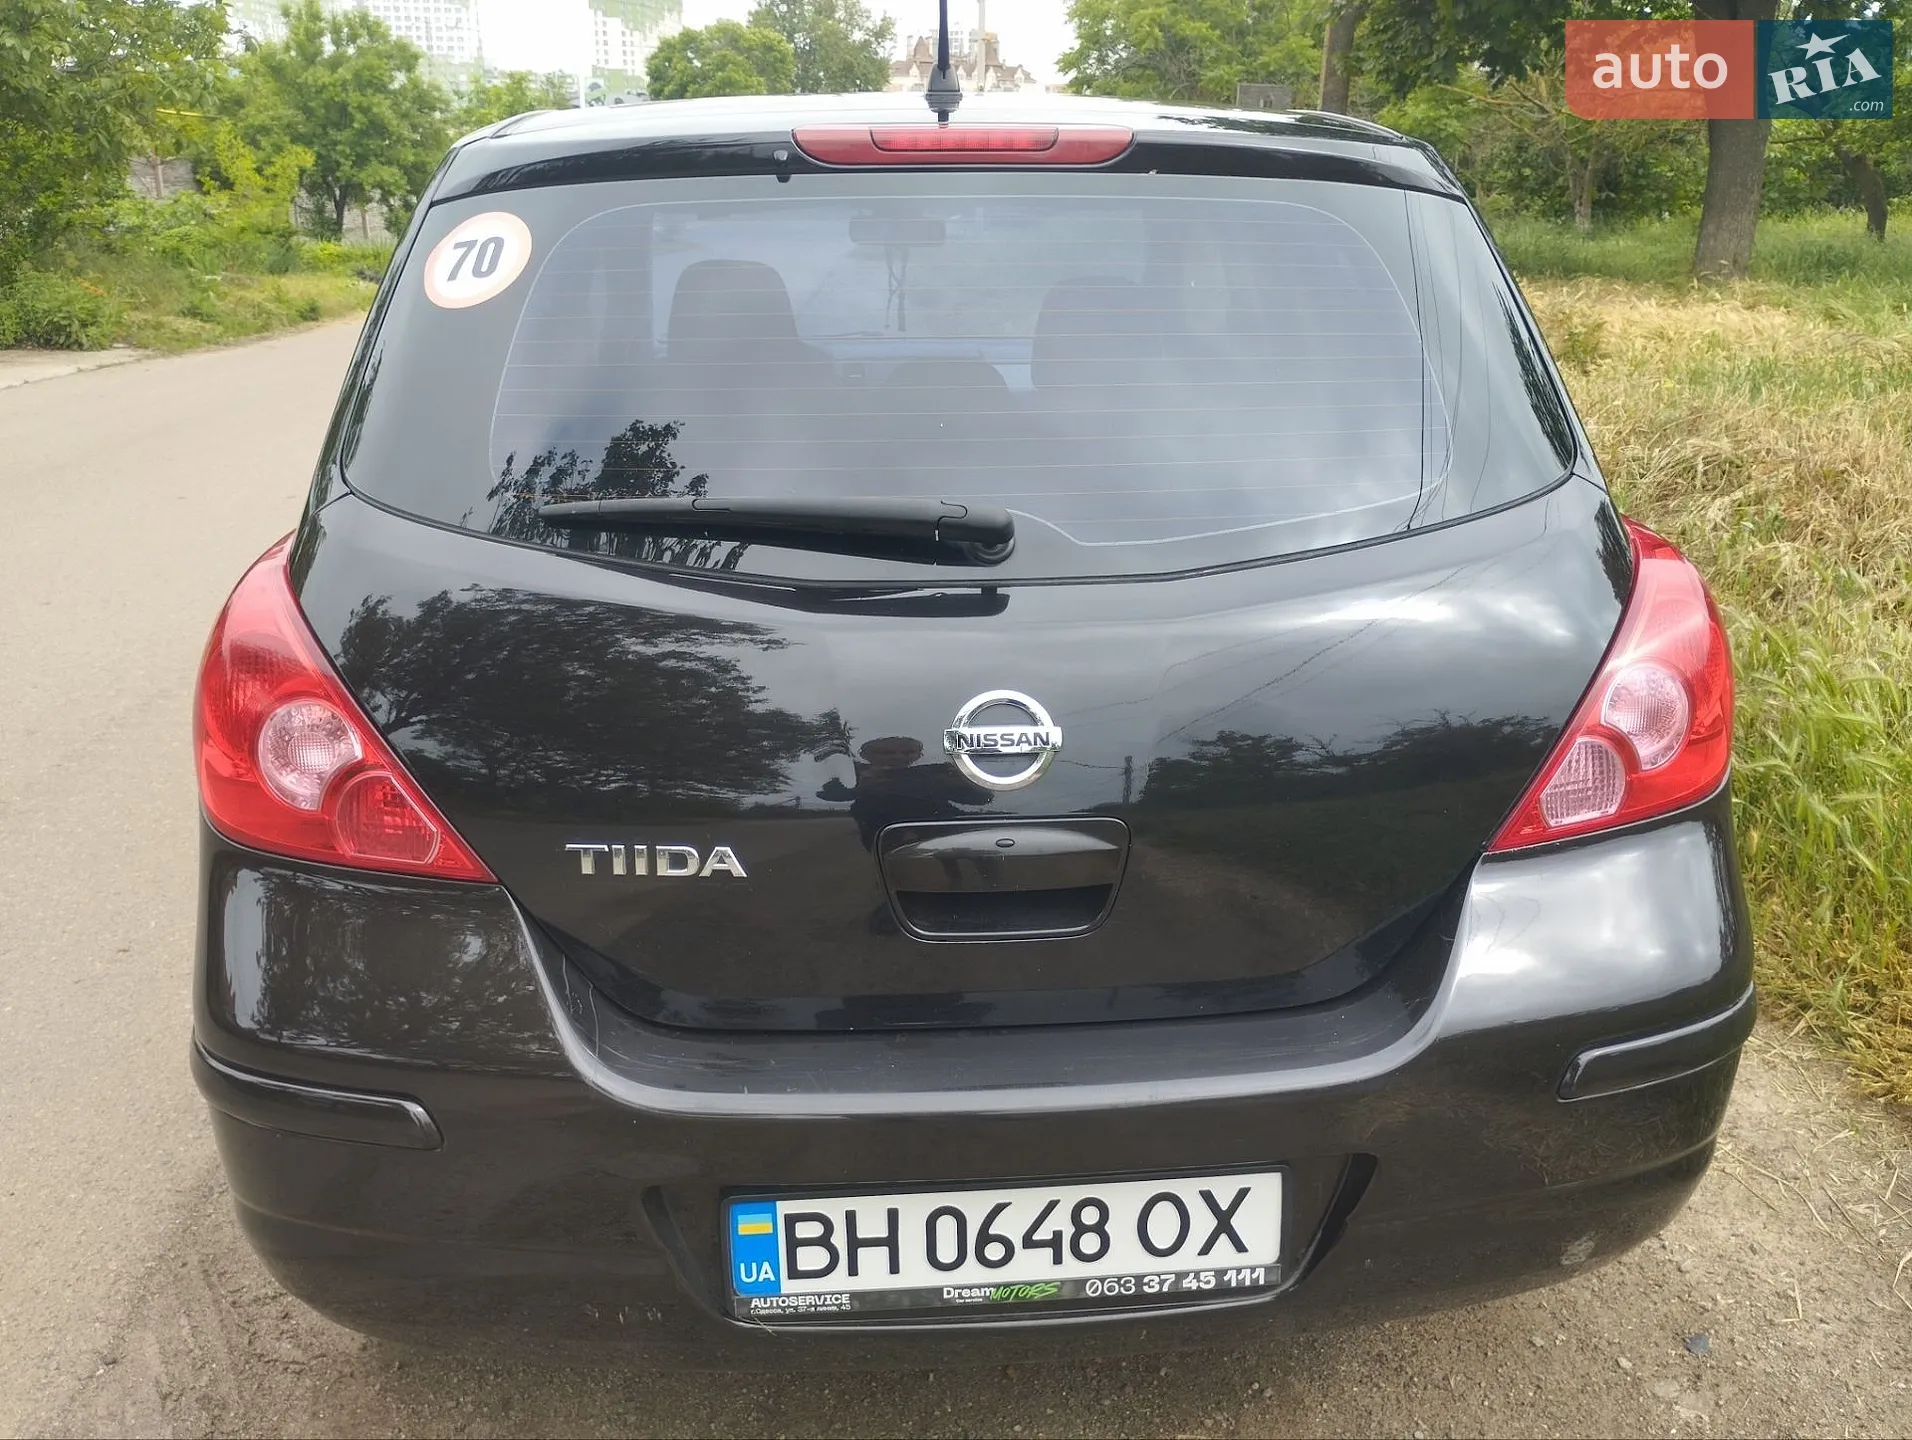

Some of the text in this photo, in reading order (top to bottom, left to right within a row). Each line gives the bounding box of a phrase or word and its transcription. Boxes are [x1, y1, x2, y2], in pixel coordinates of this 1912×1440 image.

[447, 236, 505, 282] 70
[955, 730, 1050, 749] NISSAN
[565, 843, 748, 878] TIIDA
[784, 1186, 1252, 1280] BH 0648 OX
[740, 1261, 776, 1283] UA
[1085, 1267, 1265, 1297] 063 37 45 111
[750, 1294, 850, 1309] AUTOSERVICE
[943, 1281, 1061, 1301] Dream MOTORS
